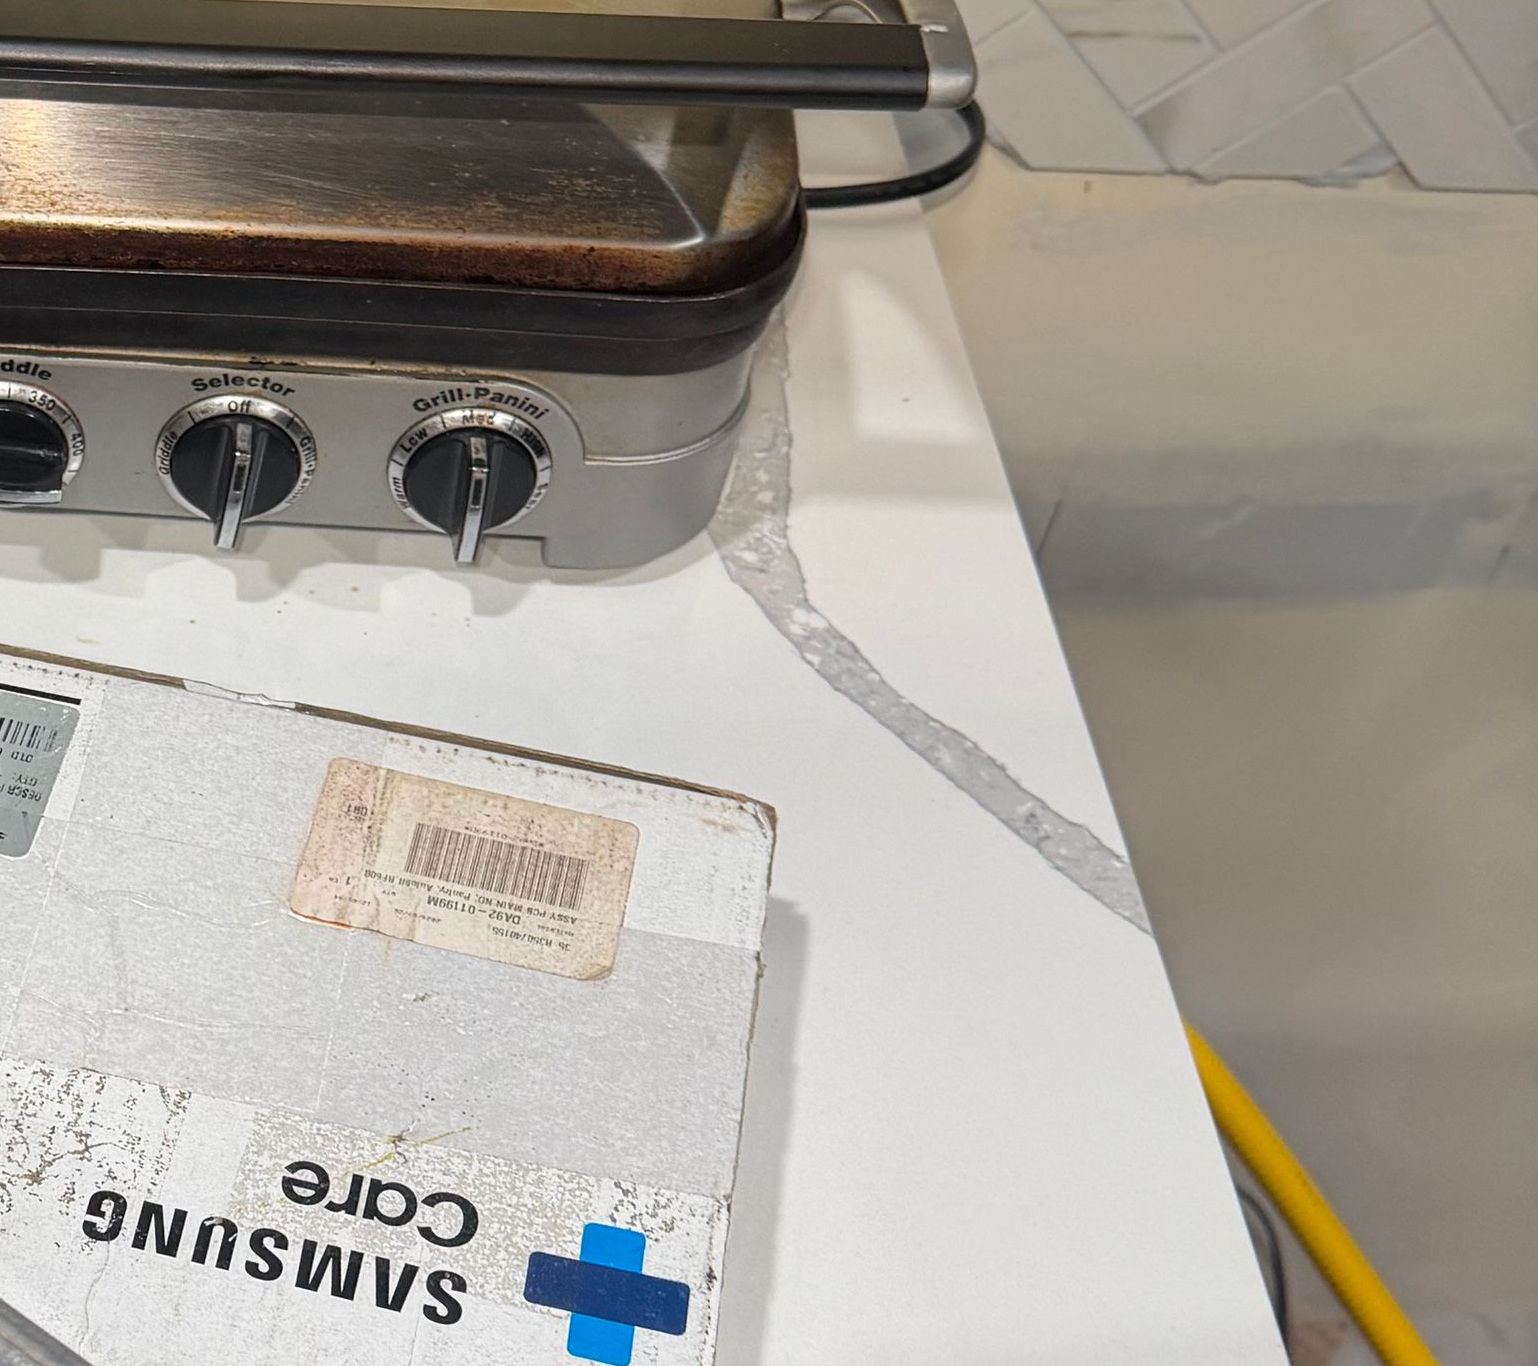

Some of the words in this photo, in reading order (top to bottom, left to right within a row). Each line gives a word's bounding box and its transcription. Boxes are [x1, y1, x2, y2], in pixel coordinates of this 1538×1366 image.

[191, 373, 295, 396] Selector
[28, 391, 56, 410] 350
[227, 400, 252, 413] Off
[462, 414, 494, 425] Med
[71, 433, 84, 456] 400
[400, 428, 428, 453] Low
[158, 431, 178, 475] Griddle
[425, 895, 523, 926] DA92-01199M
[526, 905, 547, 918] PCB
[548, 912, 578, 925] ASSY
[279, 1157, 480, 1249] Care
[82, 1188, 467, 1326] SAMSUNG
